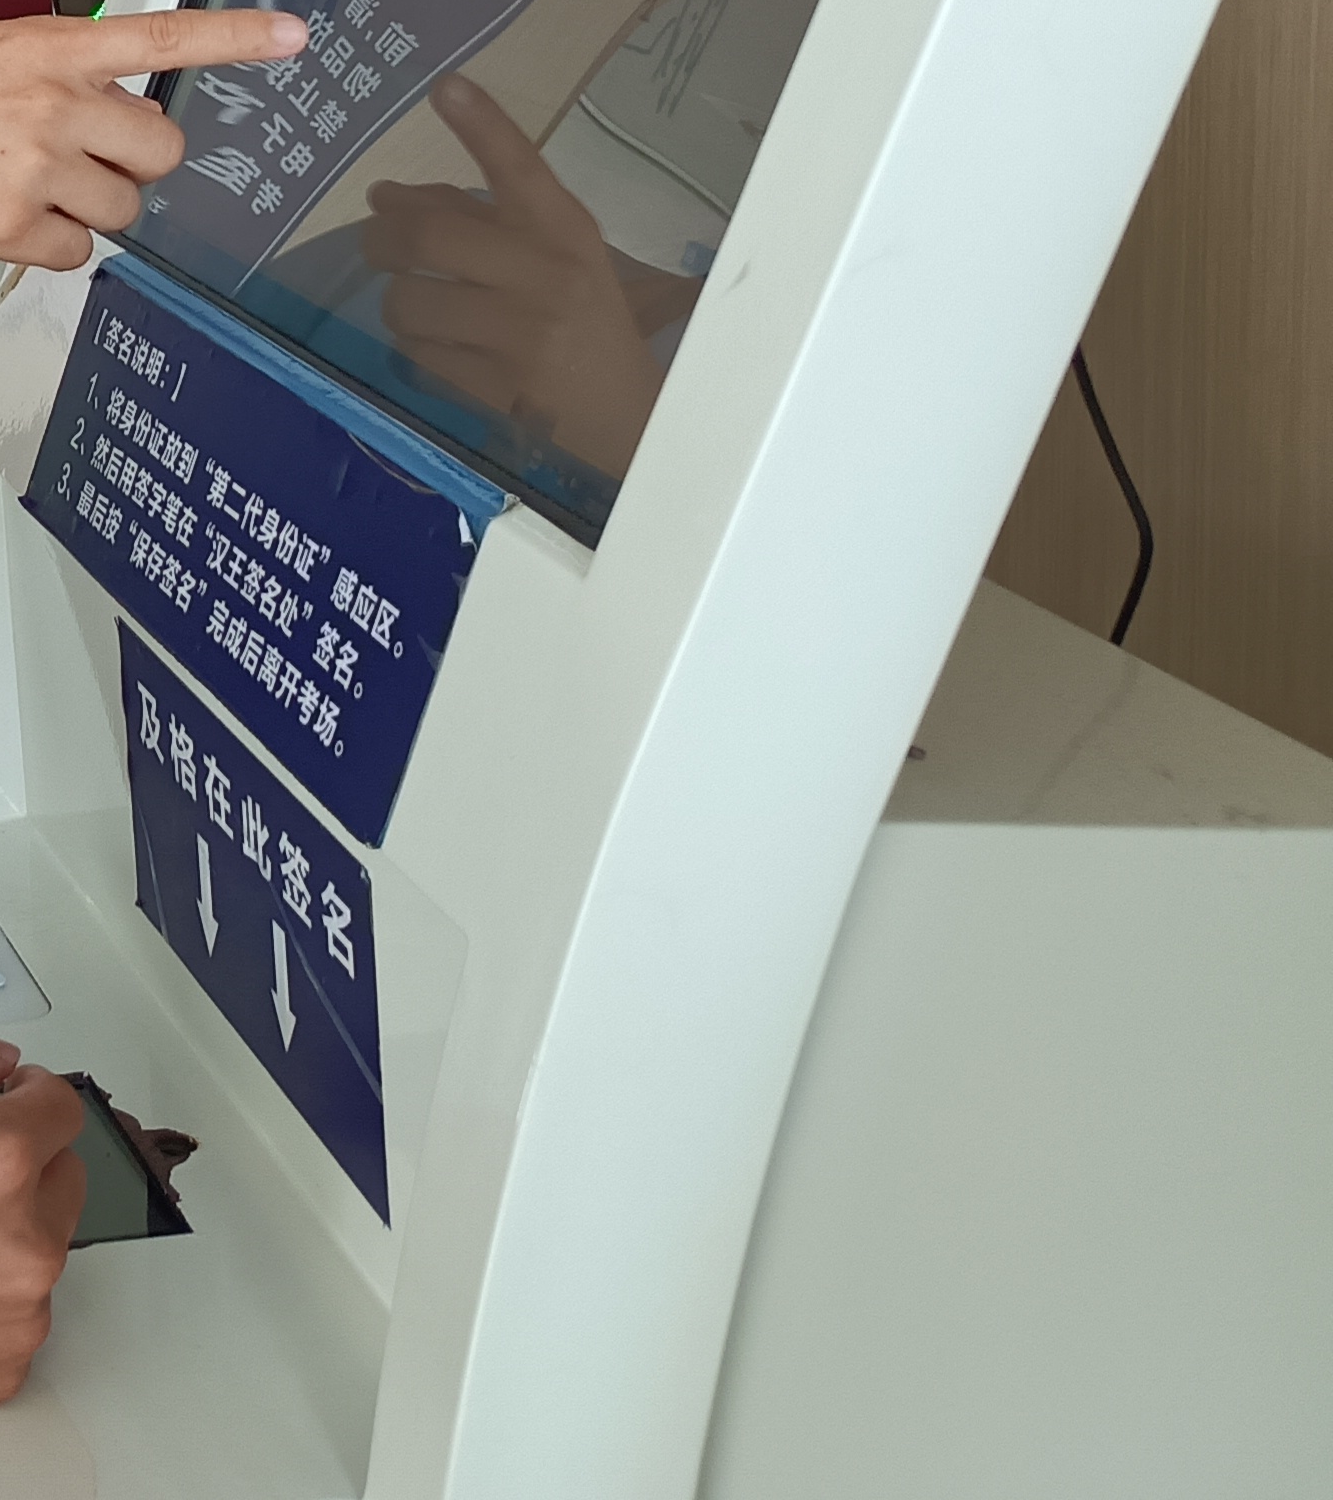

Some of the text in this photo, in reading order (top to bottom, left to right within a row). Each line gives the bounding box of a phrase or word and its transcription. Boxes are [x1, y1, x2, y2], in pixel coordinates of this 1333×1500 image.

[137, 680, 357, 981] 及格在此签名
